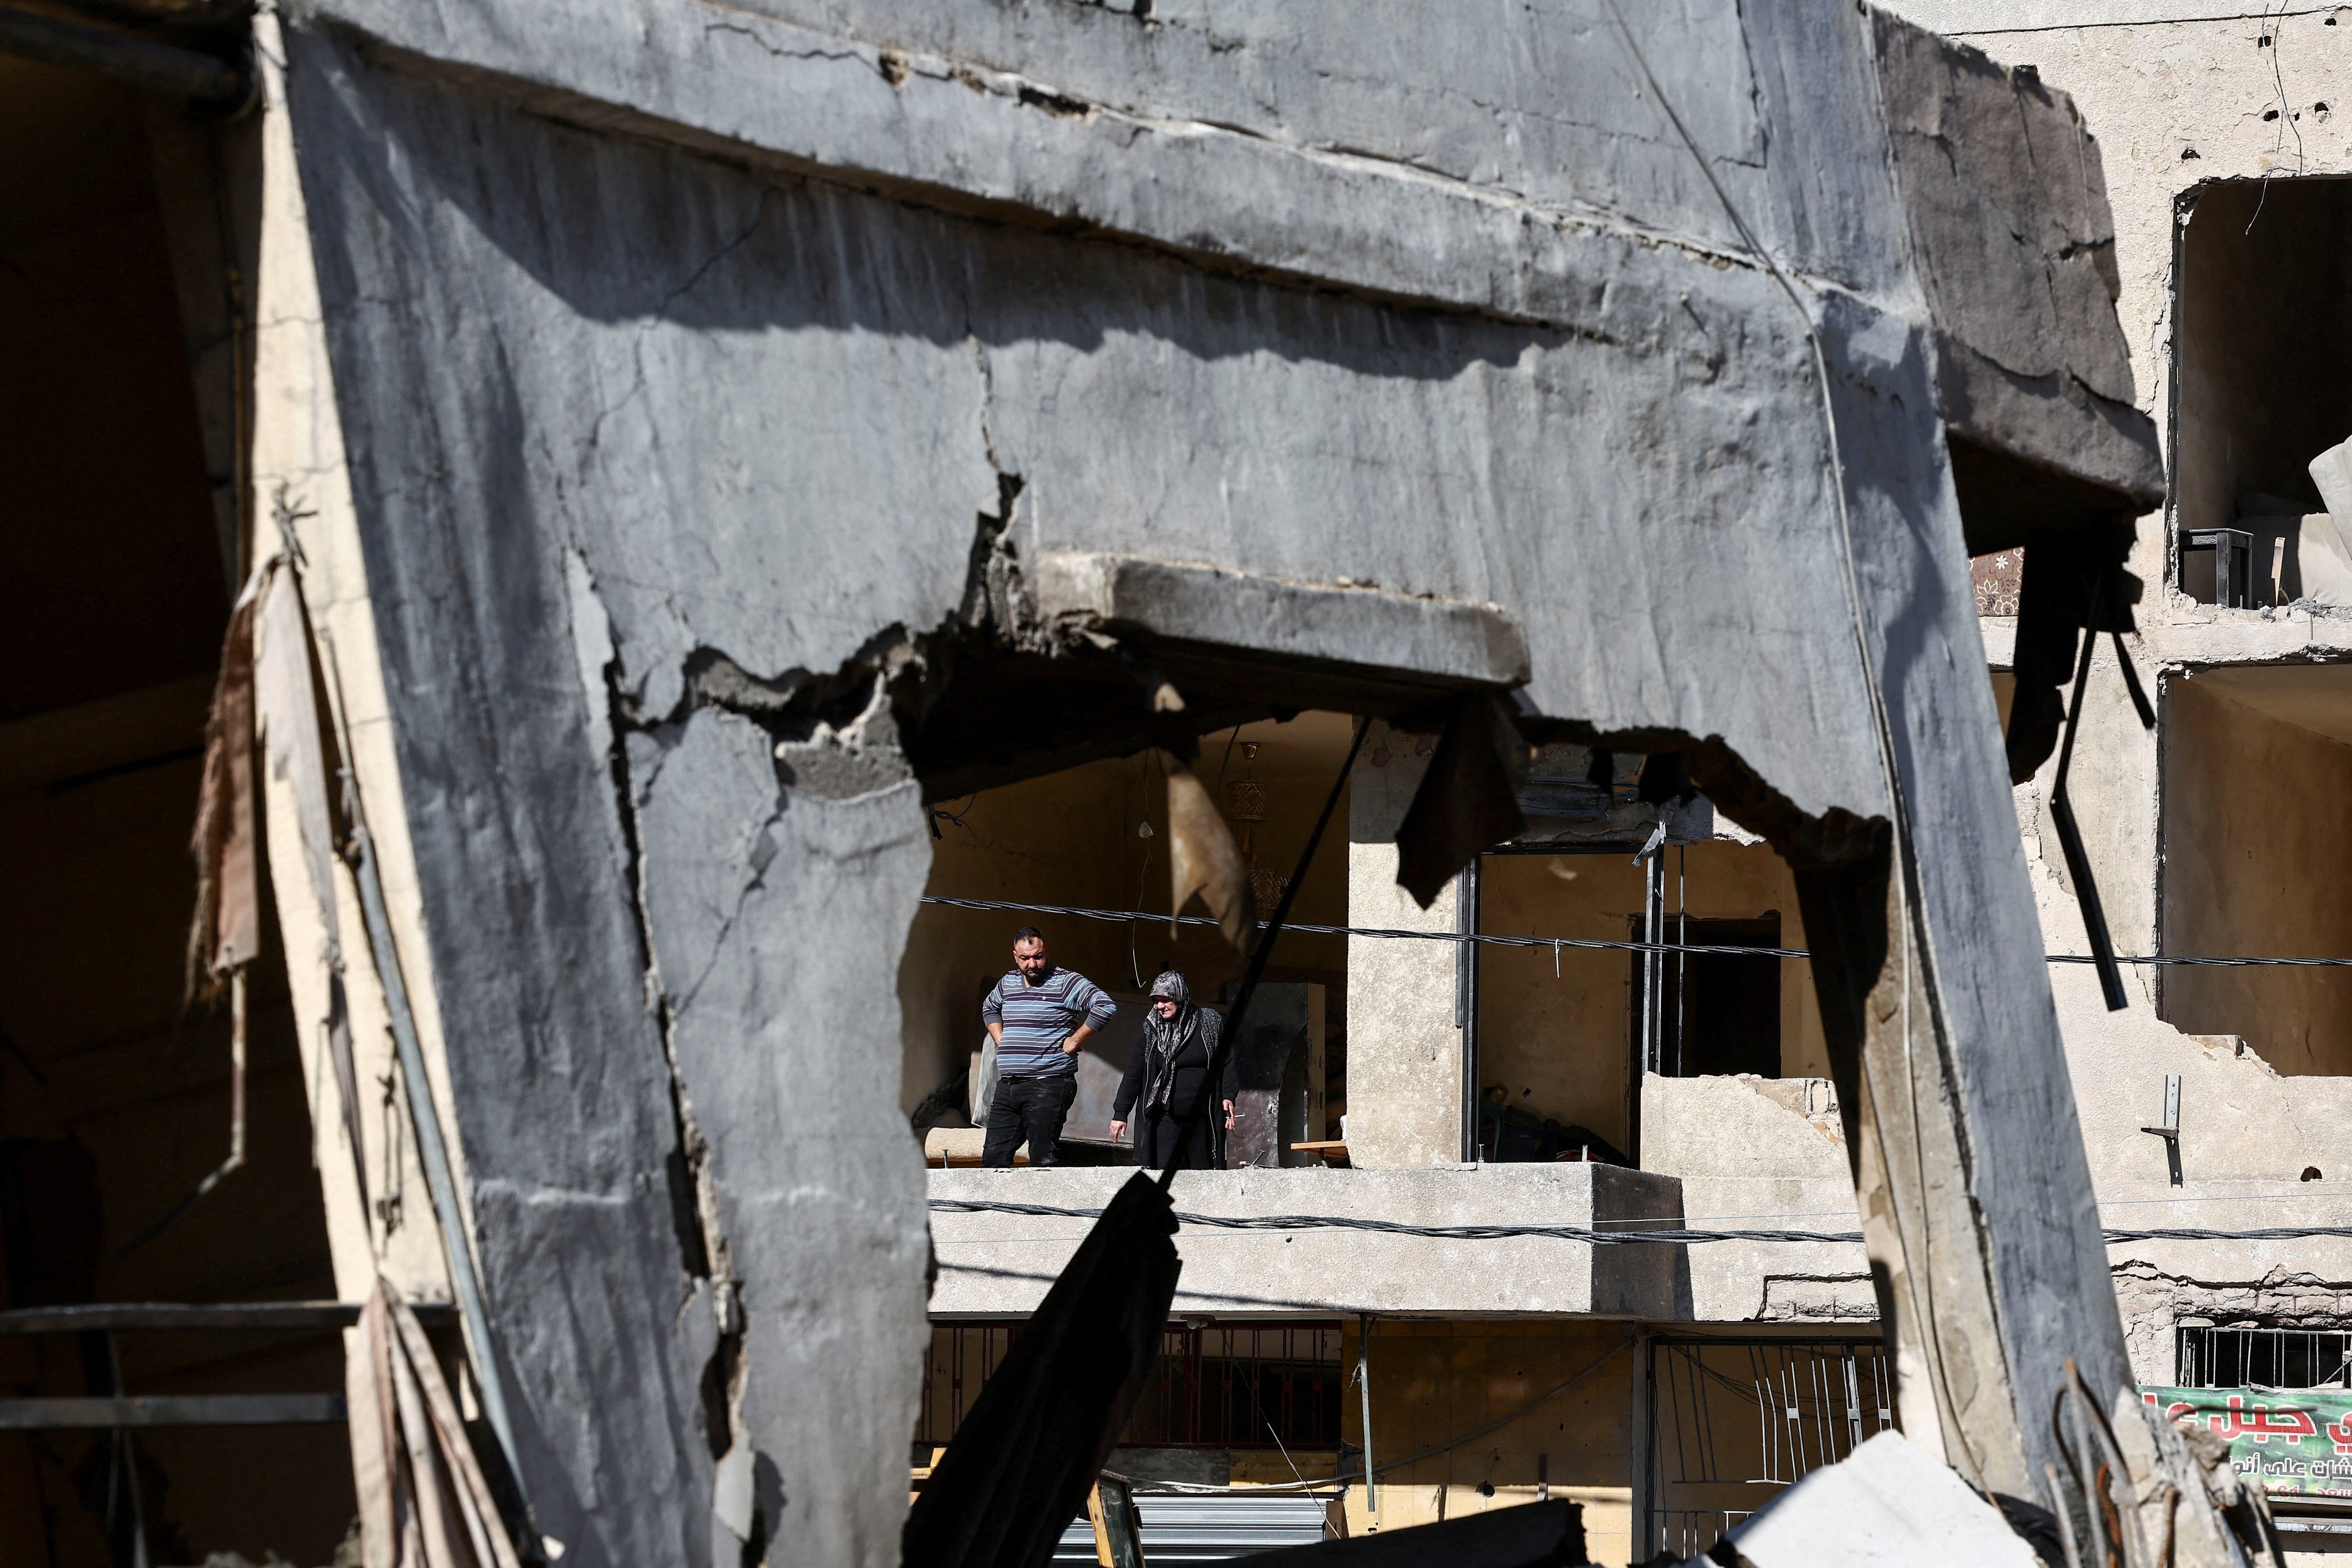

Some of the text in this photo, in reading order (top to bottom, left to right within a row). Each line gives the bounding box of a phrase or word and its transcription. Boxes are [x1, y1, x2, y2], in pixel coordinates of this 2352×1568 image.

[2209, 1396, 2316, 1444] جبل
[2229, 1452, 2260, 1477] أنو
[2264, 1458, 2307, 1478] على
